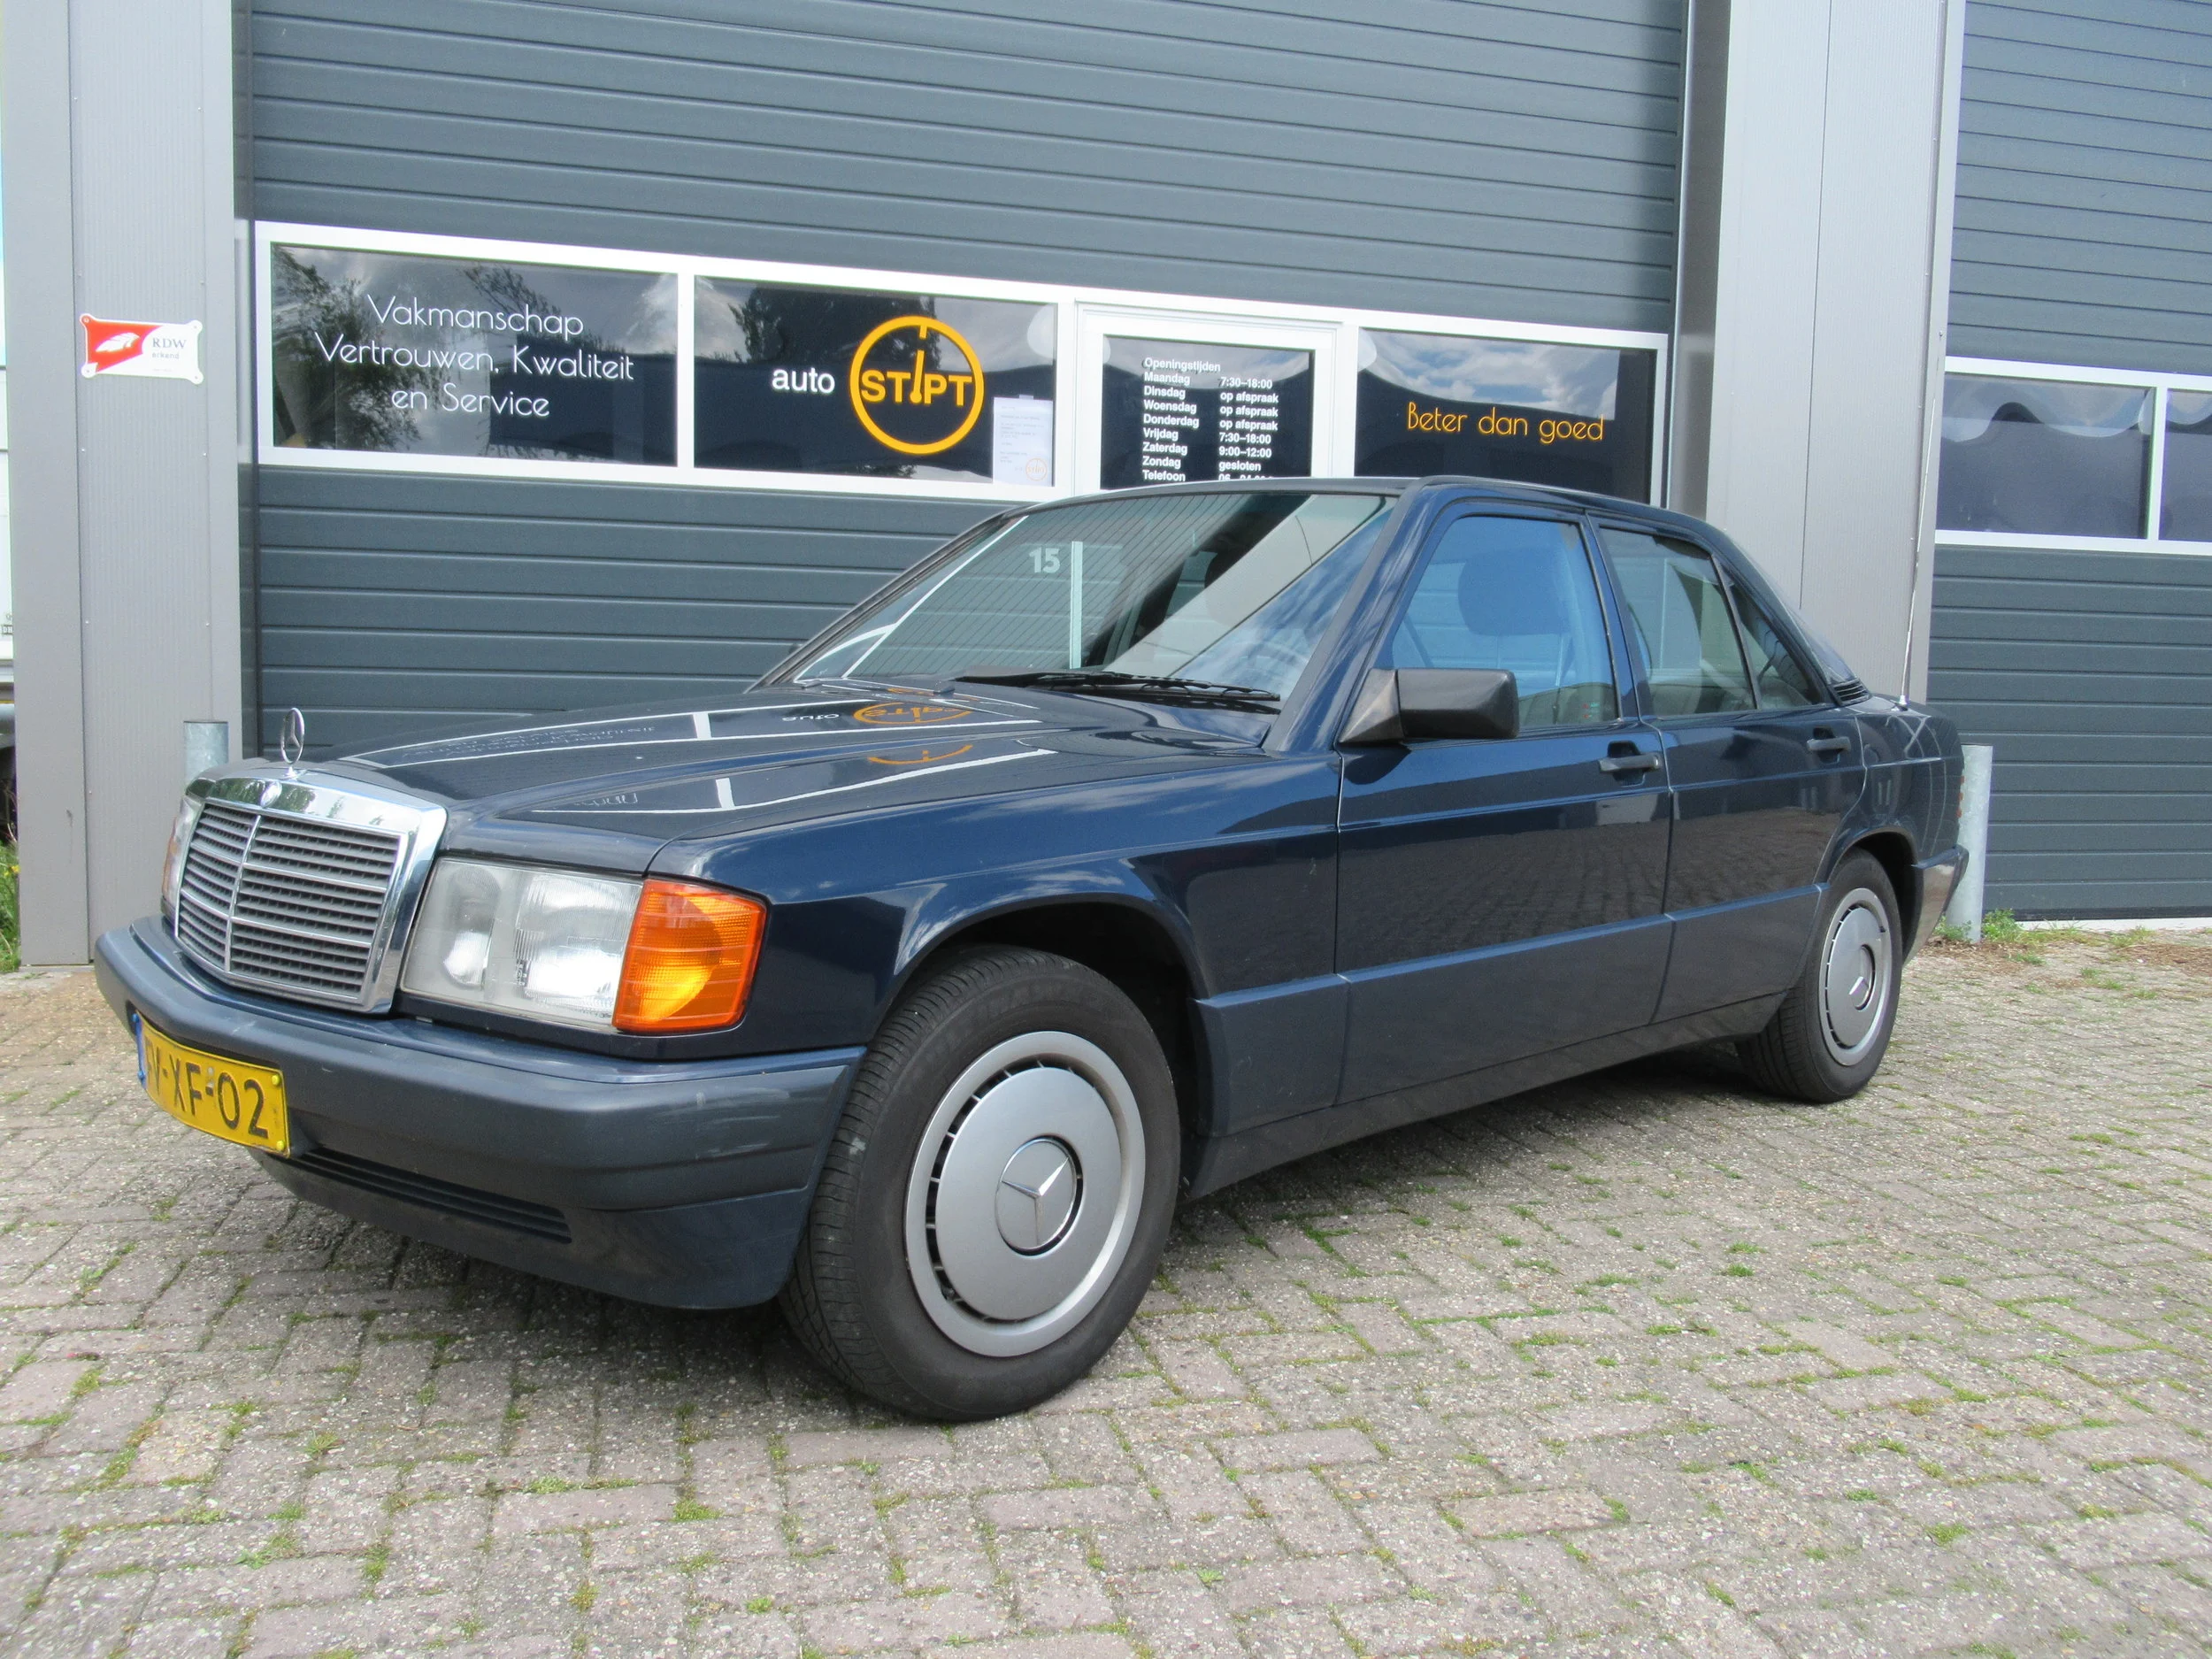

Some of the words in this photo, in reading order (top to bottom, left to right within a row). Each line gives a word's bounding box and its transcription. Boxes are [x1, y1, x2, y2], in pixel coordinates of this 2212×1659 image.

[366, 293, 584, 342] Vakmanschap
[152, 337, 187, 349] RDW
[512, 345, 634, 380] Kwaliteit
[1142, 357, 1221, 373] Openingstijden
[772, 366, 835, 394] auto
[1143, 372, 1191, 386] Maandag
[391, 388, 428, 410] en
[442, 382, 550, 418] Service
[1143, 386, 1186, 399] Dinsdag
[1219, 392, 1233, 403] op
[1235, 391, 1279, 404] afspraak
[1143, 399, 1197, 414] Woensdag
[1219, 406, 1233, 417] op
[1235, 405, 1279, 419] afspraak
[1143, 413, 1200, 428] Donderdag
[1219, 420, 1233, 431] op
[1235, 419, 1279, 433] afspraak
[1407, 402, 1468, 432] Beter
[1478, 406, 1528, 436] dan
[1539, 414, 1604, 444] goed
[1143, 427, 1179, 442] Vrijdag
[1142, 442, 1188, 456] Zaterdag
[1142, 456, 1181, 469] Zondag
[1218, 461, 1262, 472] gesloten
[1142, 469, 1186, 481] Telefoon
[1029, 547, 1061, 573] 15
